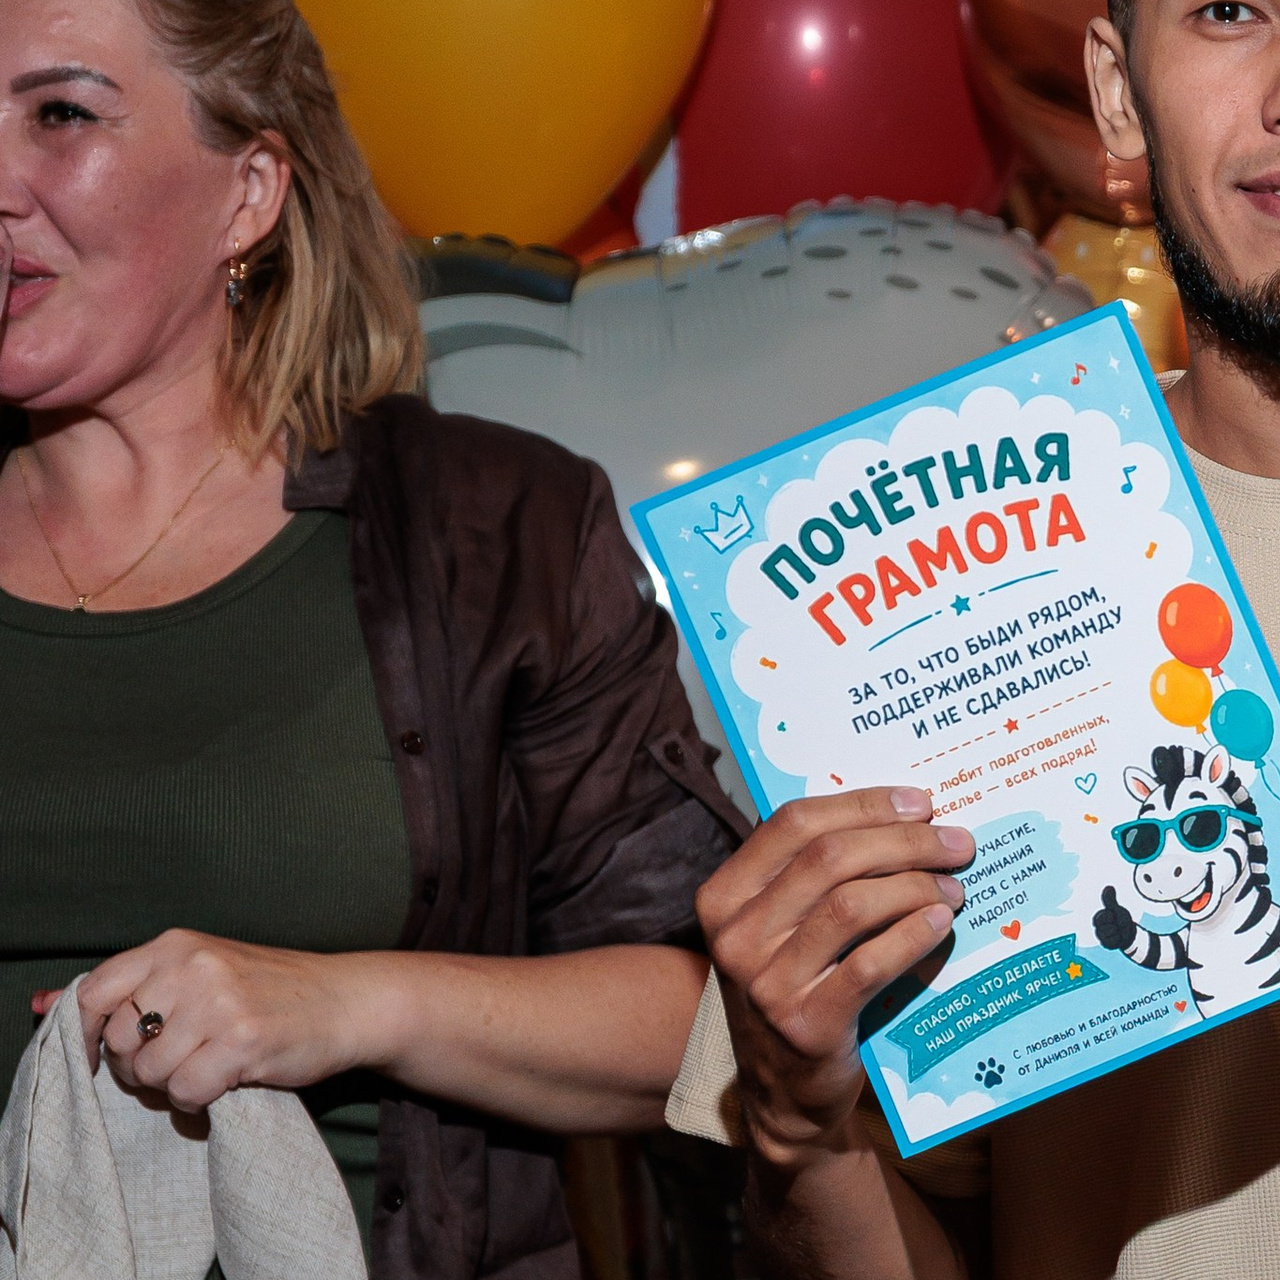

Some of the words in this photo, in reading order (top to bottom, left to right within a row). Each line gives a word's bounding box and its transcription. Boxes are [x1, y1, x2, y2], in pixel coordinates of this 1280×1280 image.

[759, 432, 1071, 600] ПОЧЁТНАЯ
[808, 492, 1086, 647] ГРАМОТА
[848, 682, 877, 705] ЗА
[880, 667, 917, 690] ТО,
[918, 646, 959, 672] ЧТО
[1027, 587, 1107, 630] РЯДОМ,
[851, 650, 1023, 734] ПОДДЕРЖИВАЛИ
[1026, 606, 1122, 659] КОМАНДУ
[912, 719, 930, 739] И
[933, 706, 962, 730] НЕ
[966, 650, 1092, 719] СДАВАЛИСЬ!
[931, 790, 983, 819] еселье
[1004, 768, 1038, 789] всех
[1040, 737, 1098, 773] подряд!
[939, 765, 984, 793] любит
[988, 714, 1111, 772] подготовленных,
[960, 843, 1034, 889] ПОМИНАНИЯ
[977, 822, 1036, 857] УЧАСТИЕ,
[960, 886, 998, 913] НУТСЯ
[1000, 879, 1010, 891] С
[1011, 859, 1047, 885] НАМИ
[968, 890, 1029, 930] НАДОЛГО!
[913, 993, 977, 1037] СПАСИБО,
[977, 976, 1004, 996] ЧТО
[1004, 949, 1063, 986] ДЕЛАЕТЕ
[925, 1030, 956, 1054] НАШ
[955, 990, 1024, 1034] ПРАЗДНИК
[1025, 970, 1063, 996] ЯРЧЕ!
[1012, 1049, 1022, 1060] С
[1025, 1027, 1076, 1056] ЛЮБОВЬЮ
[1078, 1021, 1087, 1032] И
[1089, 984, 1178, 1028] БЛАГОДАРНОСТЬЮ
[1017, 1064, 1030, 1076] ОТ
[1034, 1043, 1081, 1072] ДАНИЭЛЯ
[1082, 1040, 1091, 1050] И
[1094, 1026, 1119, 1045] ВСЕЙ
[1120, 1005, 1170, 1032] КОМАНДЫ
